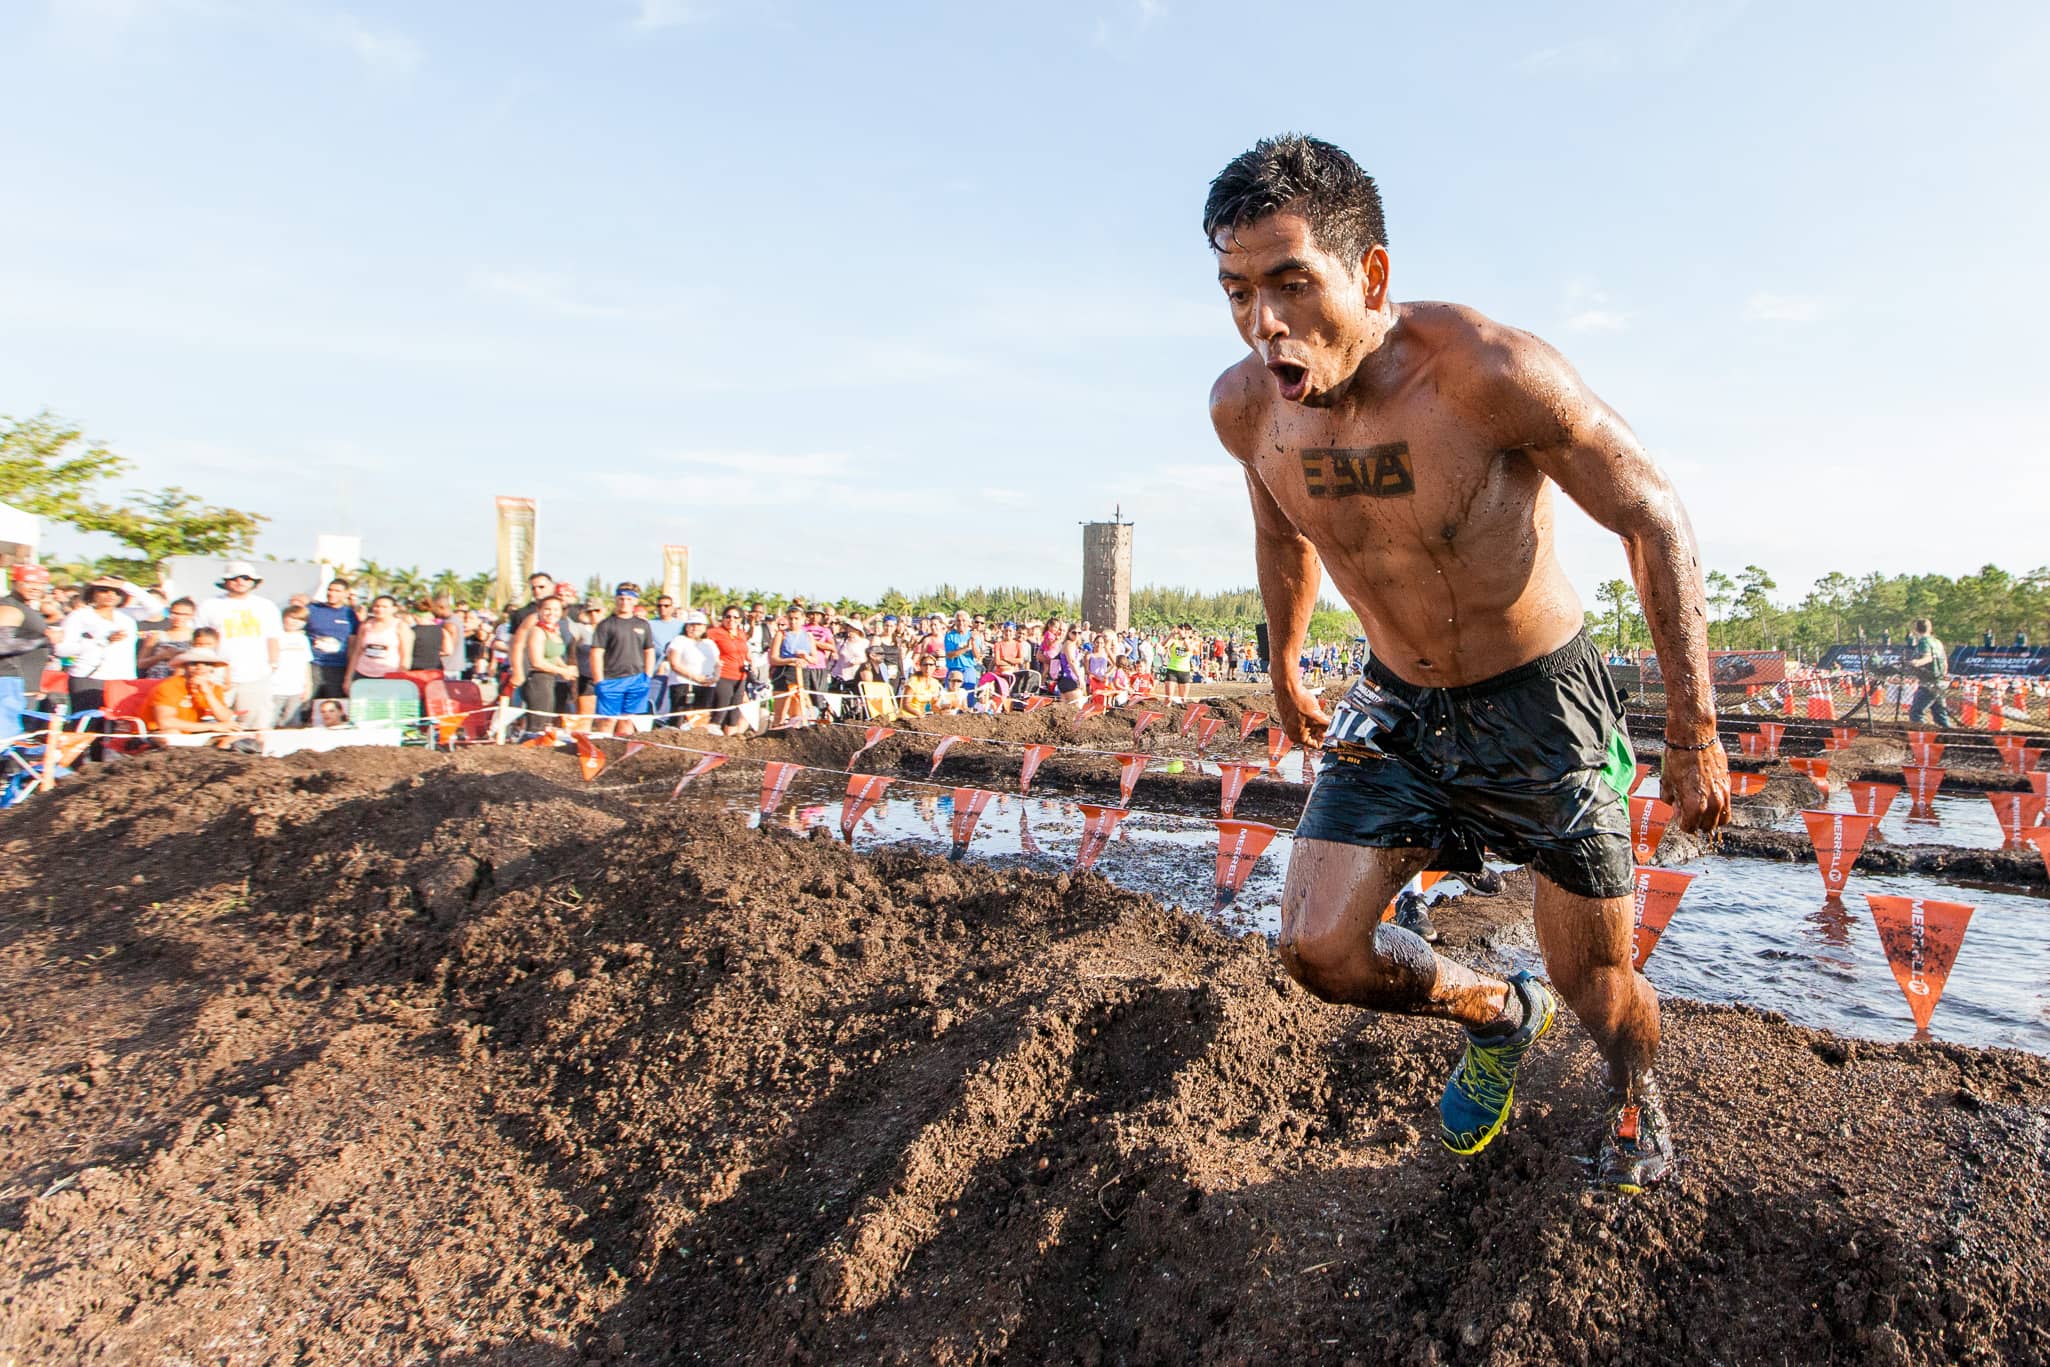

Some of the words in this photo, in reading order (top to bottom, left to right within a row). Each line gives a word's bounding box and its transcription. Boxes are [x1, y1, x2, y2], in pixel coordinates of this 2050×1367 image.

[1639, 800, 1654, 842] MERRELL
[1831, 815, 1842, 868] MERRELL
[1225, 828, 1248, 886] MERRELL
